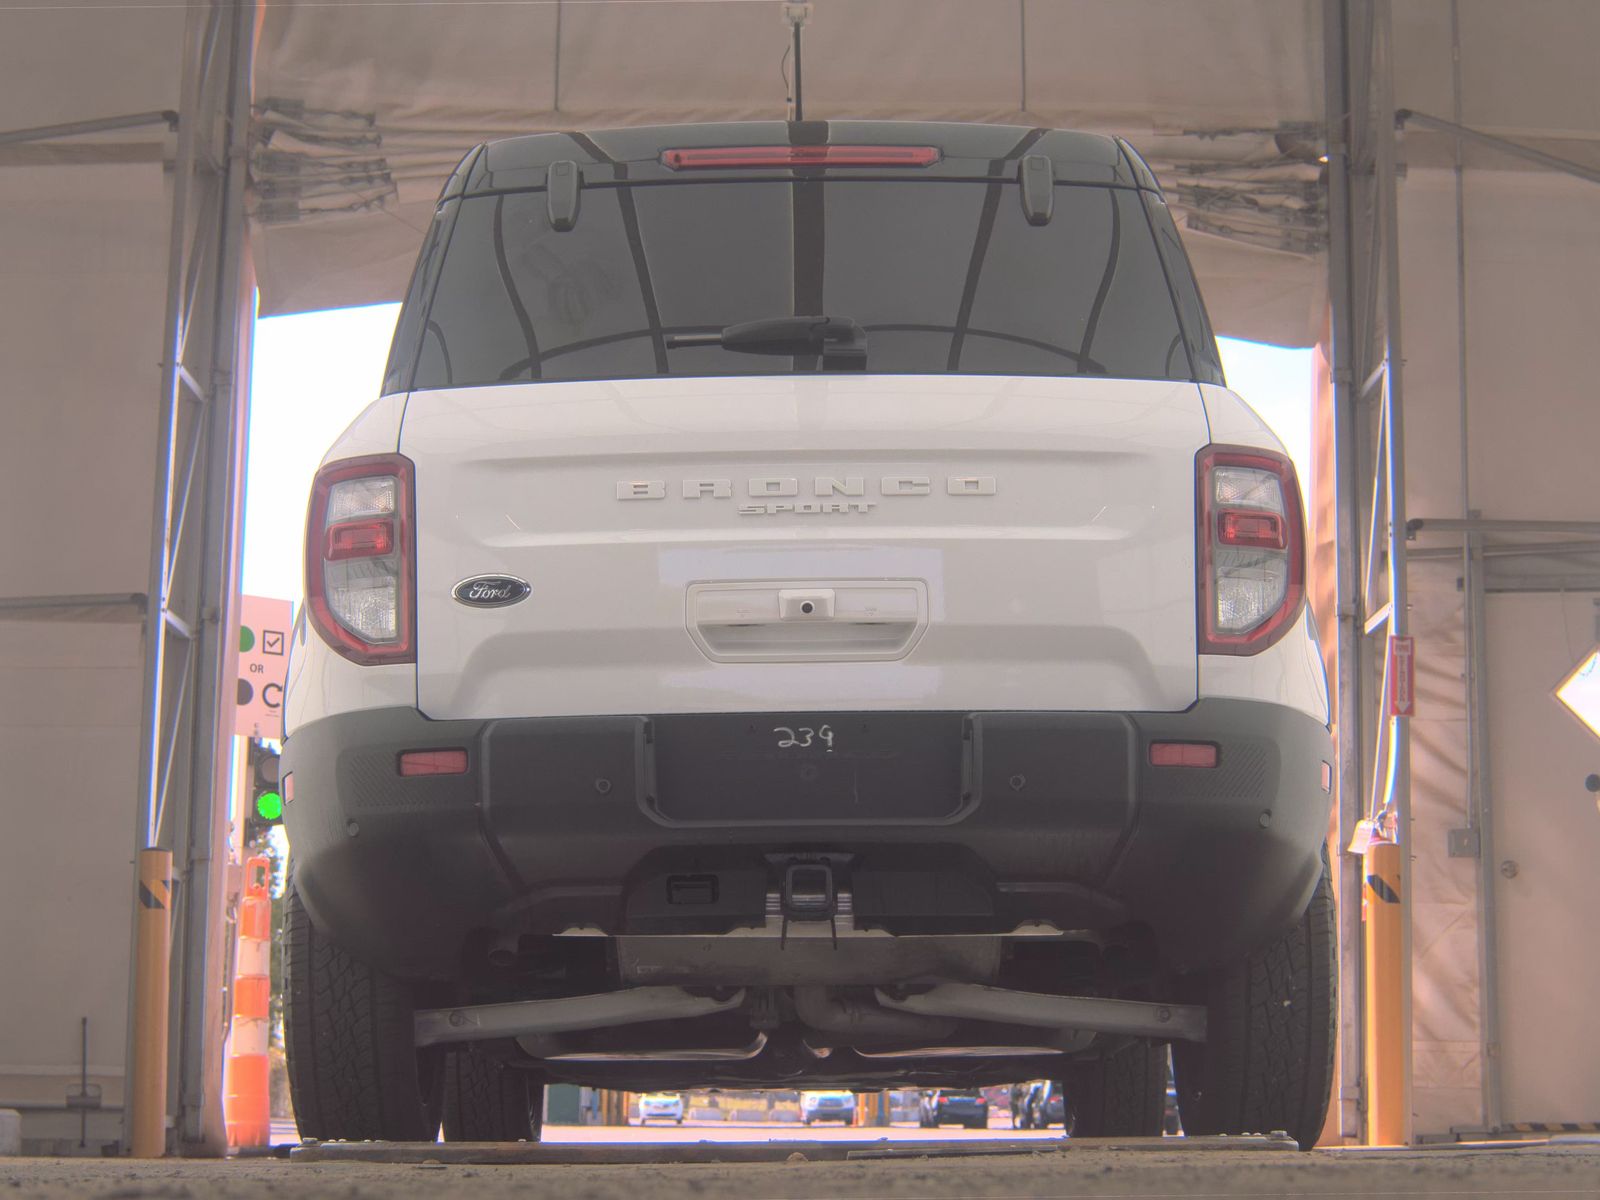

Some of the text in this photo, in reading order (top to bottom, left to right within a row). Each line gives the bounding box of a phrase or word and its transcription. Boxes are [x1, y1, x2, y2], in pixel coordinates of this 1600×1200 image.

[616, 476, 997, 501] BRONCO
[738, 502, 876, 515] SPORT
[469, 581, 512, 599] Ford
[249, 663, 264, 674] OR
[773, 724, 834, 752] 239
